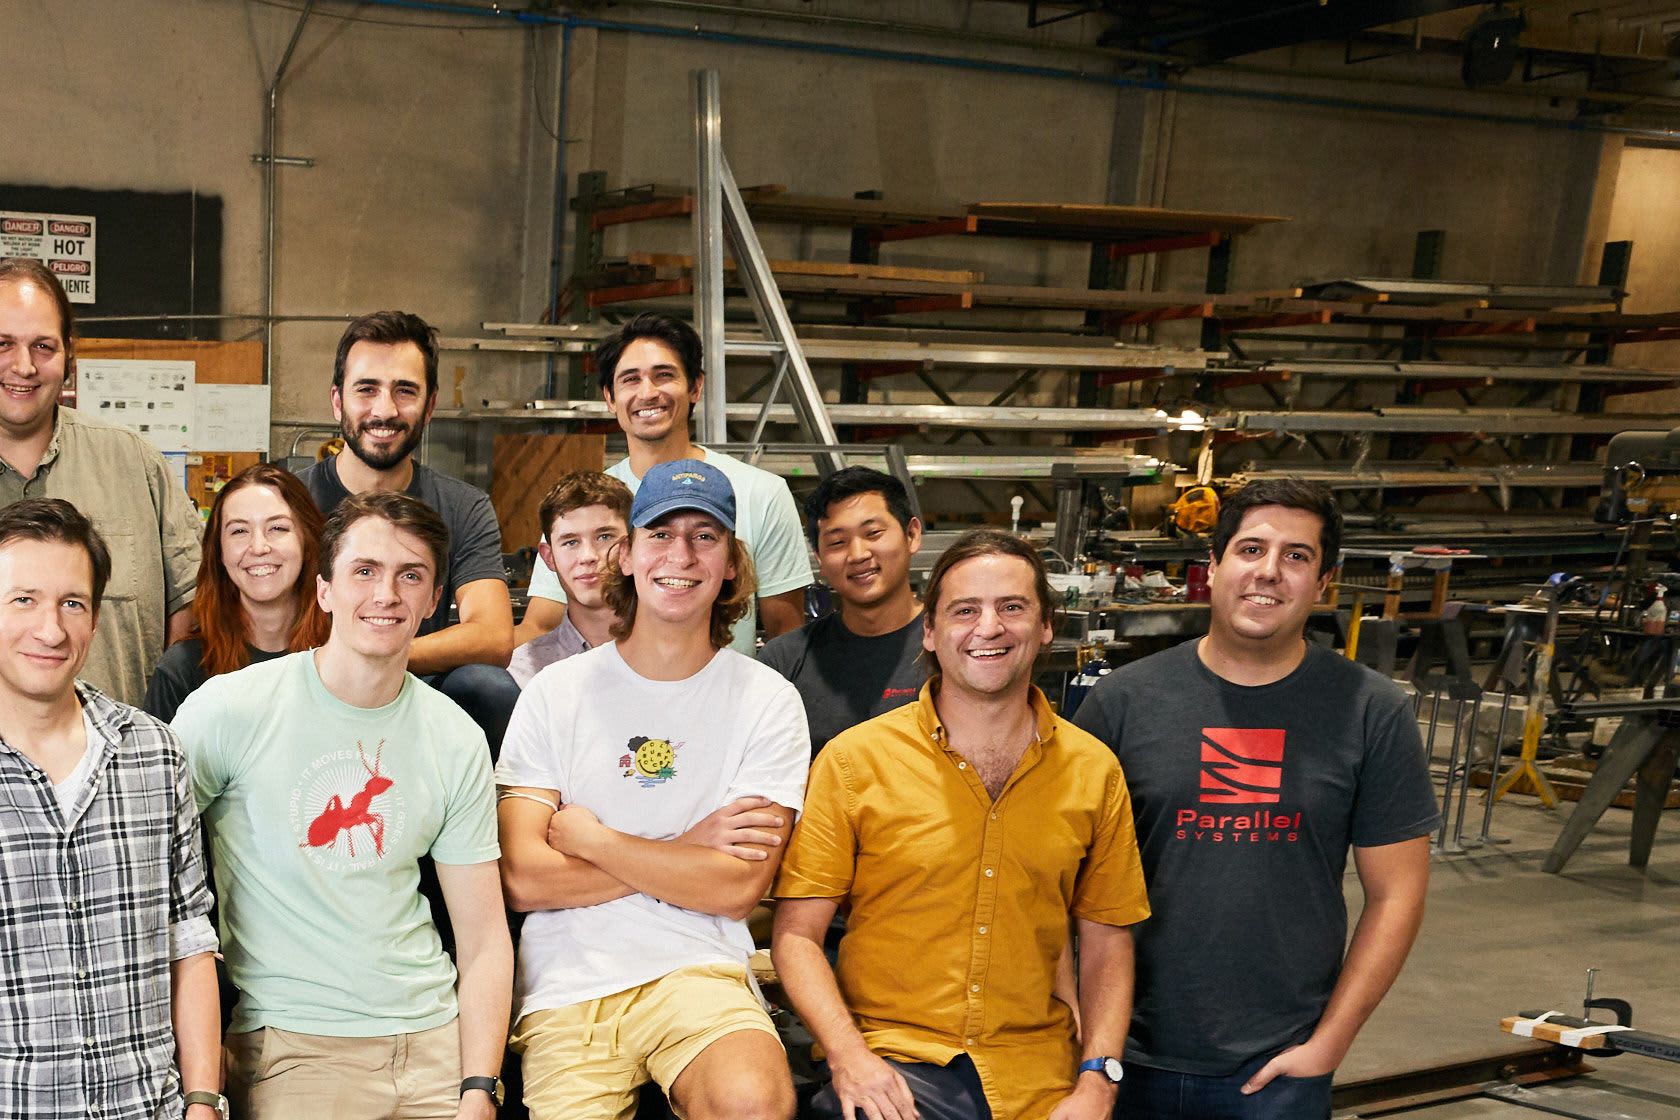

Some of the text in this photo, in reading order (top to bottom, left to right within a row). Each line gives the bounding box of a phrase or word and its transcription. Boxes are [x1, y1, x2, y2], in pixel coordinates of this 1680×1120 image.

[4, 222, 39, 231] DANGER
[53, 224, 86, 233] DANGER
[53, 239, 85, 255] HOT
[52, 263, 86, 272] PELIGRO
[60, 279, 90, 294] IENTE
[311, 751, 353, 769] MOVES
[289, 788, 303, 833] STUPID
[1176, 808, 1302, 829] Parallel
[1176, 829, 1299, 842] SYSTEMS
